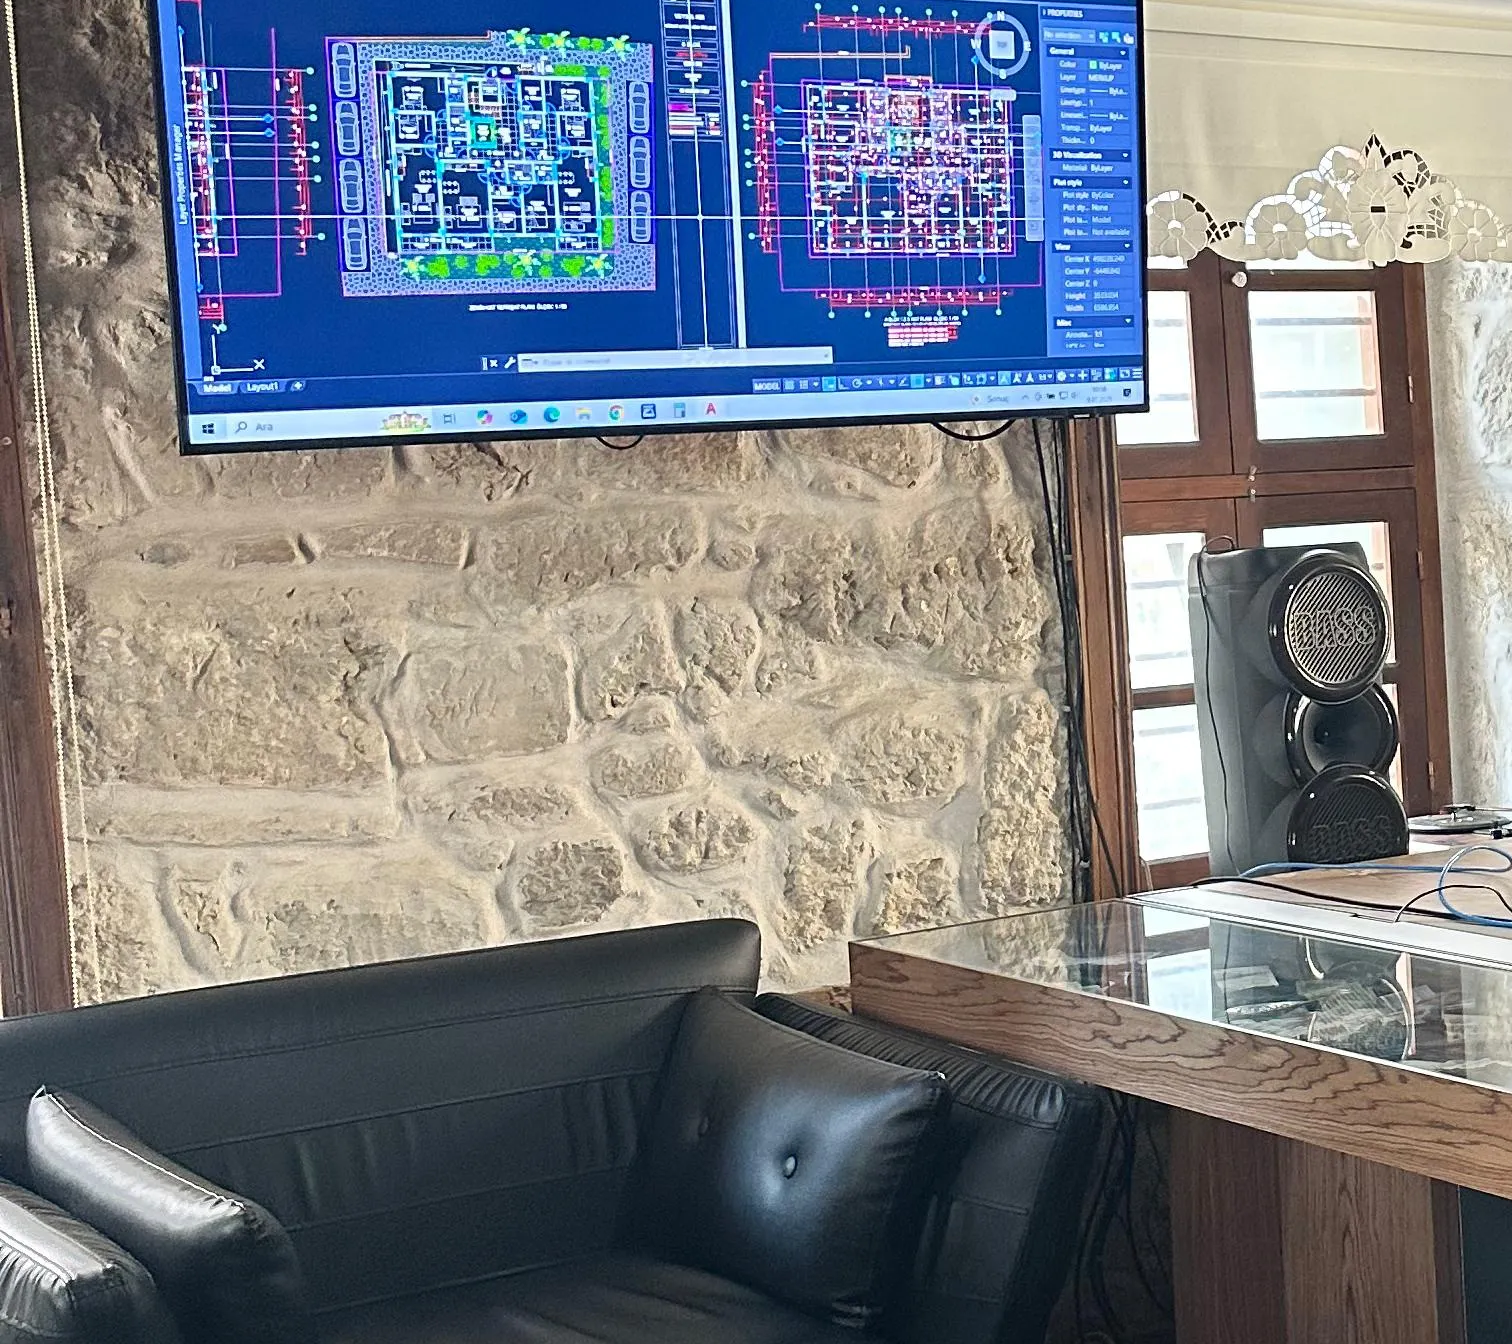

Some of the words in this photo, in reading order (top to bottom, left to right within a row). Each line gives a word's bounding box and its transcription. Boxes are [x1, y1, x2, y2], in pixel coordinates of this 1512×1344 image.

[996, 11, 1005, 22] N
[1047, 8, 1084, 18] PROPERTIES
[1050, 46, 1075, 56] General
[172, 124, 183, 161] Manager
[175, 162, 186, 202] Properties
[1053, 178, 1066, 186] Plot
[1067, 179, 1083, 188] style
[178, 203, 188, 225] Layer
[203, 383, 232, 393] Model
[247, 382, 279, 393] Layout1
[753, 382, 781, 391] MODEL
[256, 423, 274, 431] Ara
[1294, 606, 1378, 651] BASS
